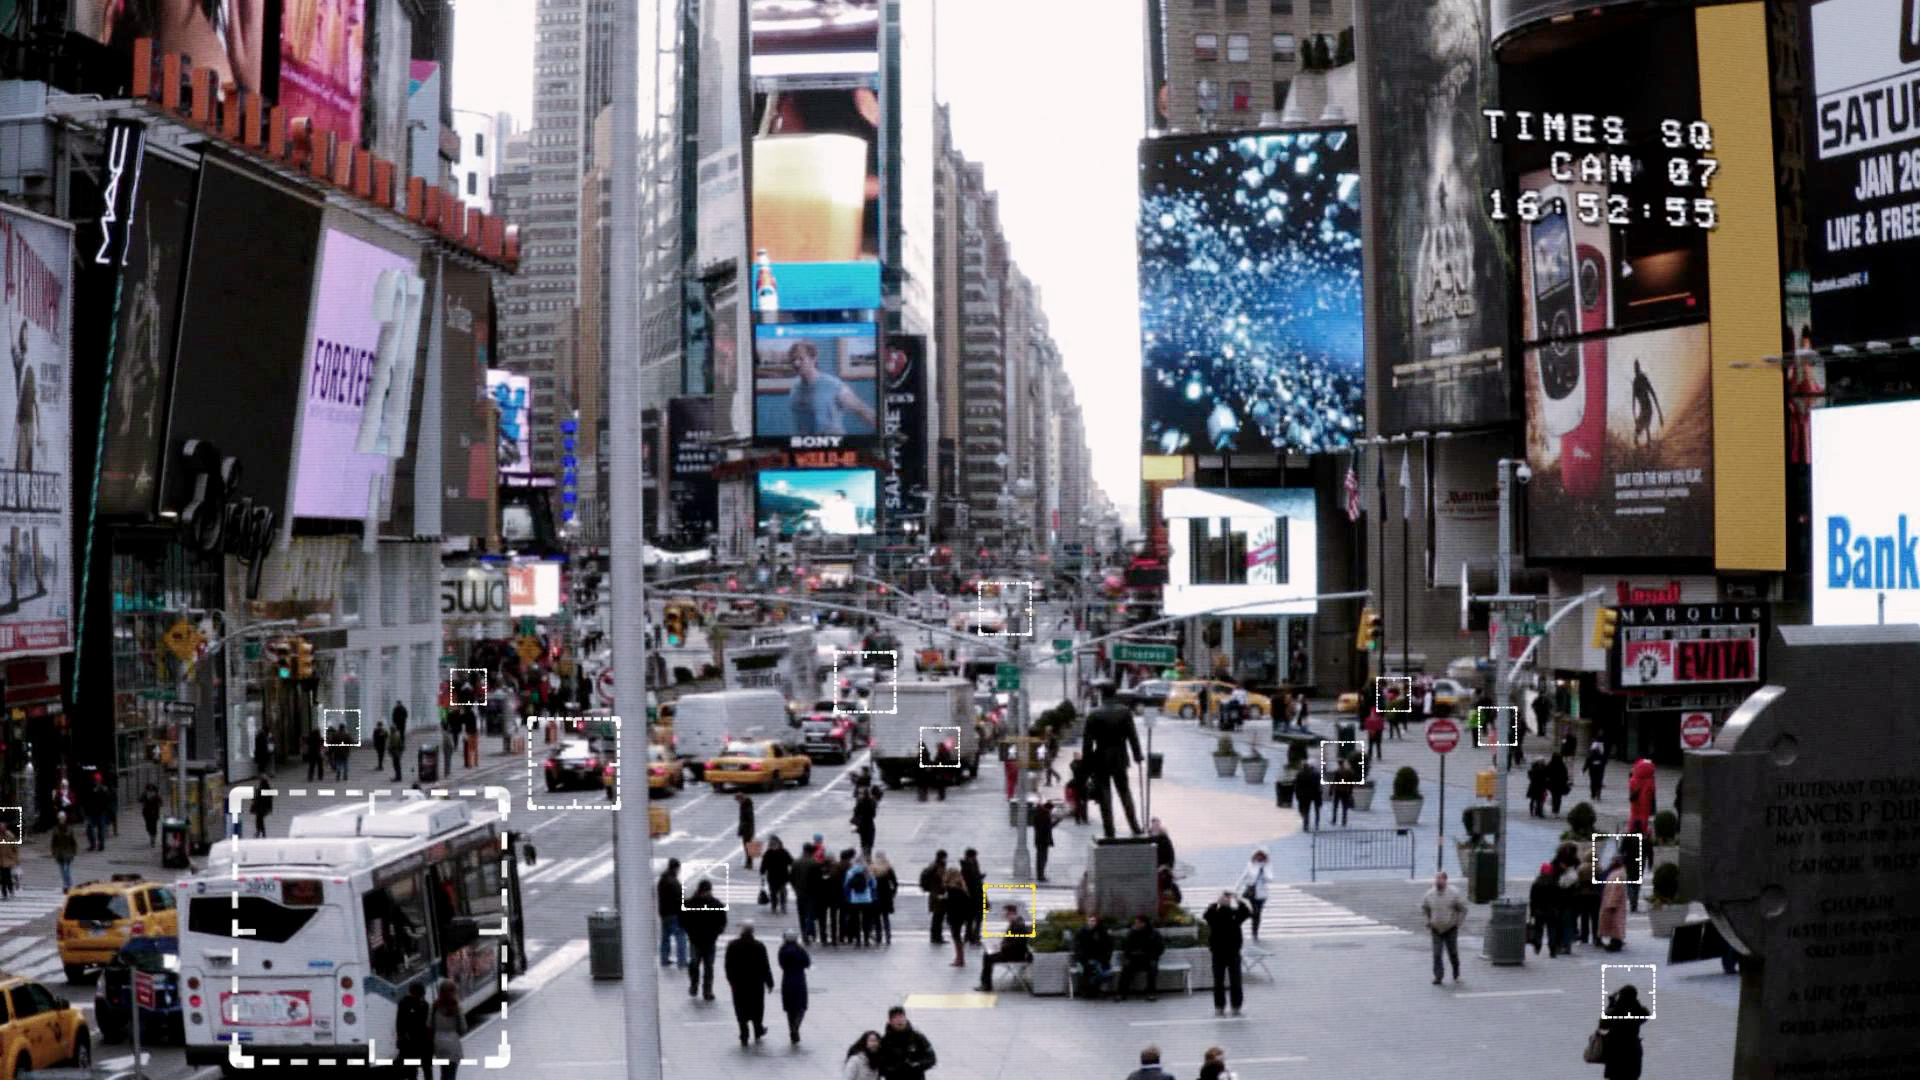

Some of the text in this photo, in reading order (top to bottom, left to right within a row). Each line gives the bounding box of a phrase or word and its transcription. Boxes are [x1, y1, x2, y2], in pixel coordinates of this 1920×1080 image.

[1855, 153, 1894, 202] JAN
[1827, 203, 1920, 252] LIVE & FREE
[790, 436, 844, 448] SONY
[1827, 513, 1920, 589] Bank
[1620, 606, 1761, 623] MARQUIS
[1679, 641, 1755, 681] EVITA
[1766, 801, 1854, 827] FRANCIS
